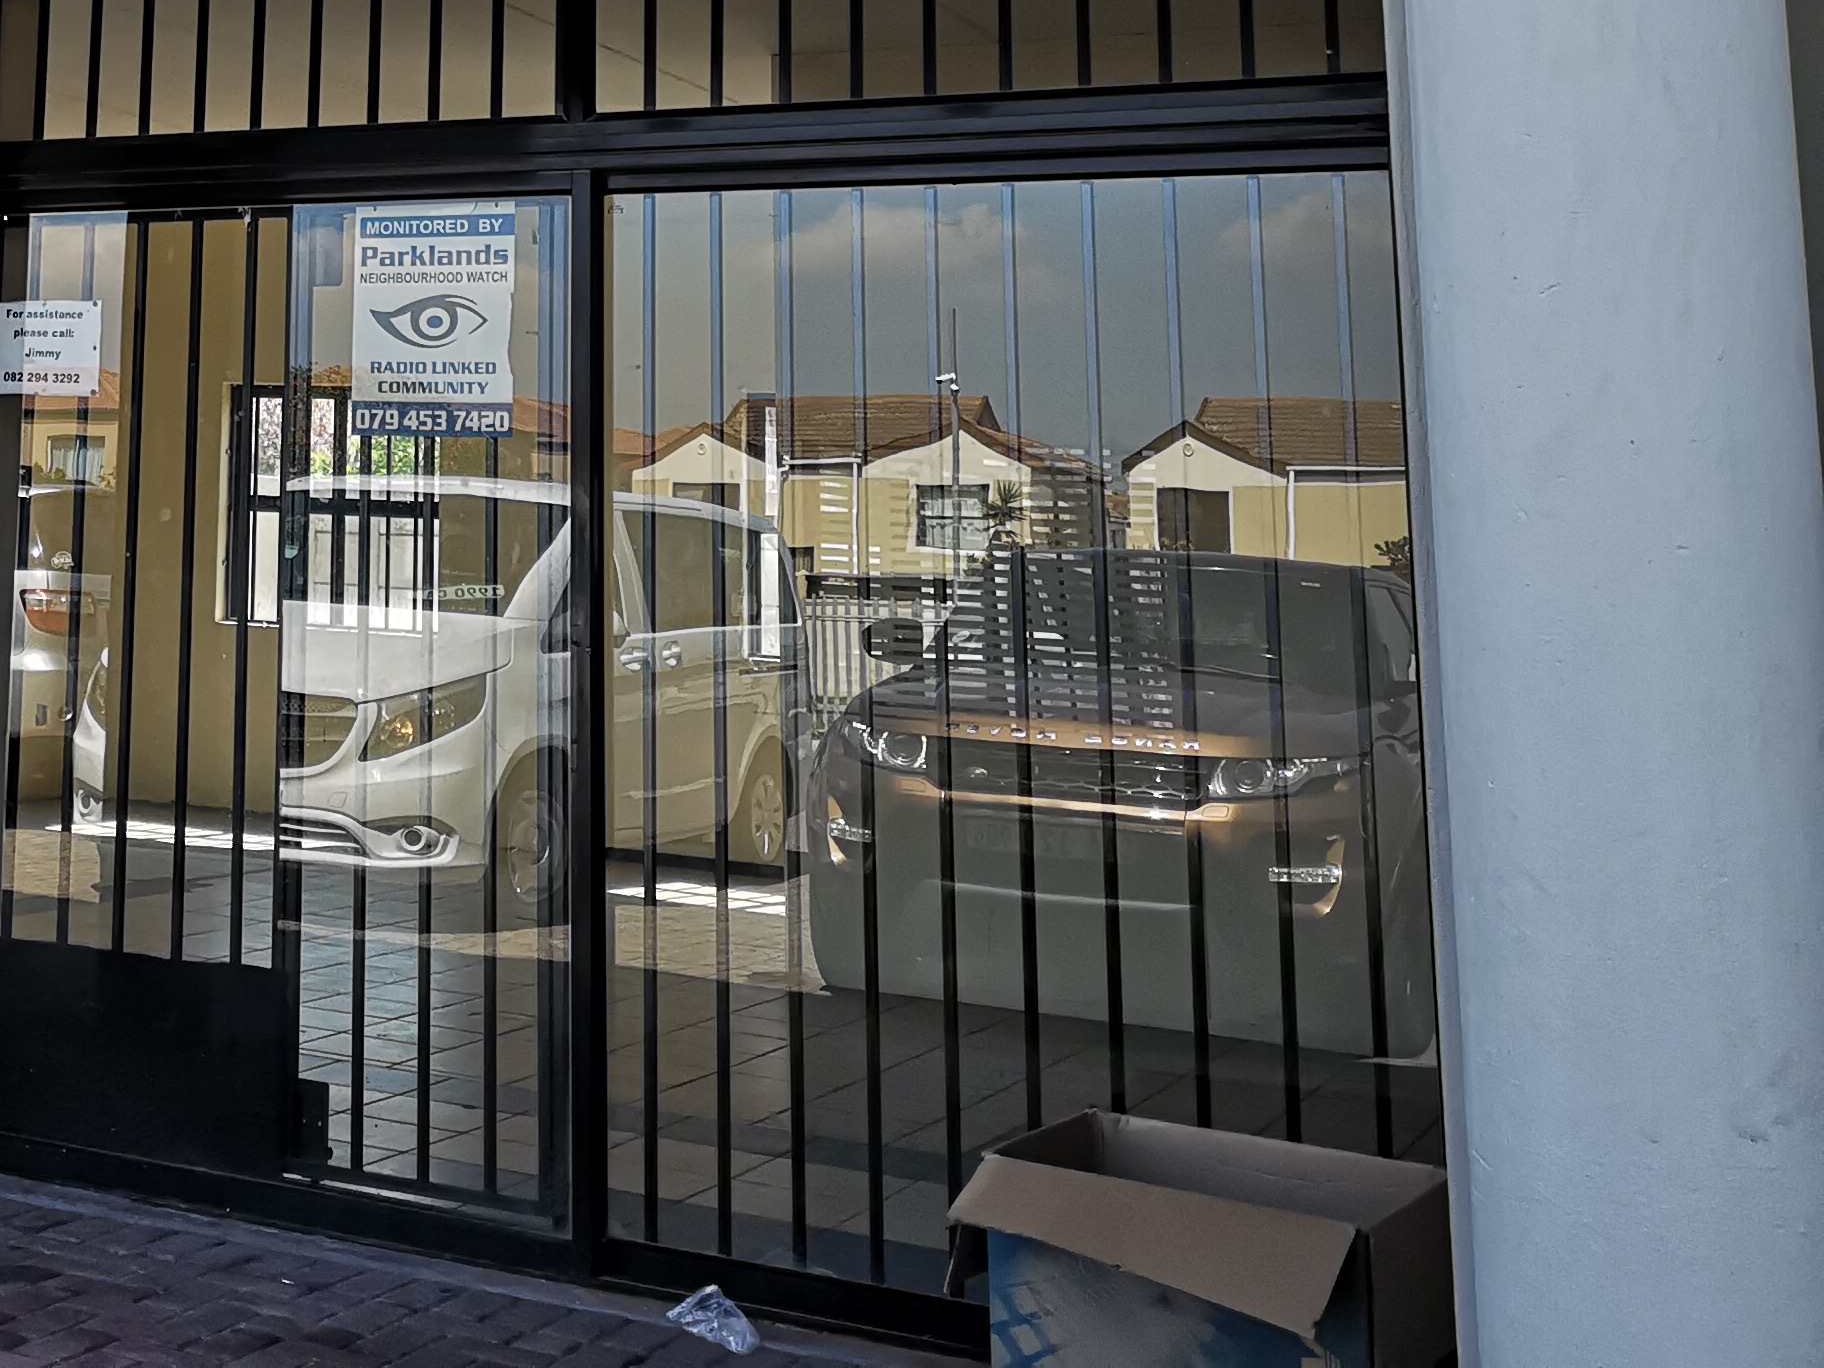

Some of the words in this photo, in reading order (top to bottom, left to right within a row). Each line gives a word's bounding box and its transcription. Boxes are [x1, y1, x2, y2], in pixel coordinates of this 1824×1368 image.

[366, 220, 469, 235] MONITORED
[478, 218, 504, 233] BY
[360, 244, 509, 268] Parklands
[360, 272, 463, 284] NEIGHBOURHOOD
[466, 271, 508, 283] WATCH
[6, 309, 24, 319] For
[26, 309, 84, 319] assistance
[13, 328, 49, 339] please
[51, 328, 75, 338] call:
[24, 347, 62, 360] Jimmy
[370, 361, 427, 375] RADIO
[432, 361, 497, 375] LINKED
[3, 371, 24, 383] 082
[26, 372, 49, 383] 294
[52, 372, 80, 384] 3292
[378, 380, 489, 395] COMMUNITY
[355, 409, 399, 430] 079
[403, 410, 448, 431] 453
[454, 410, 510, 432] 7420
